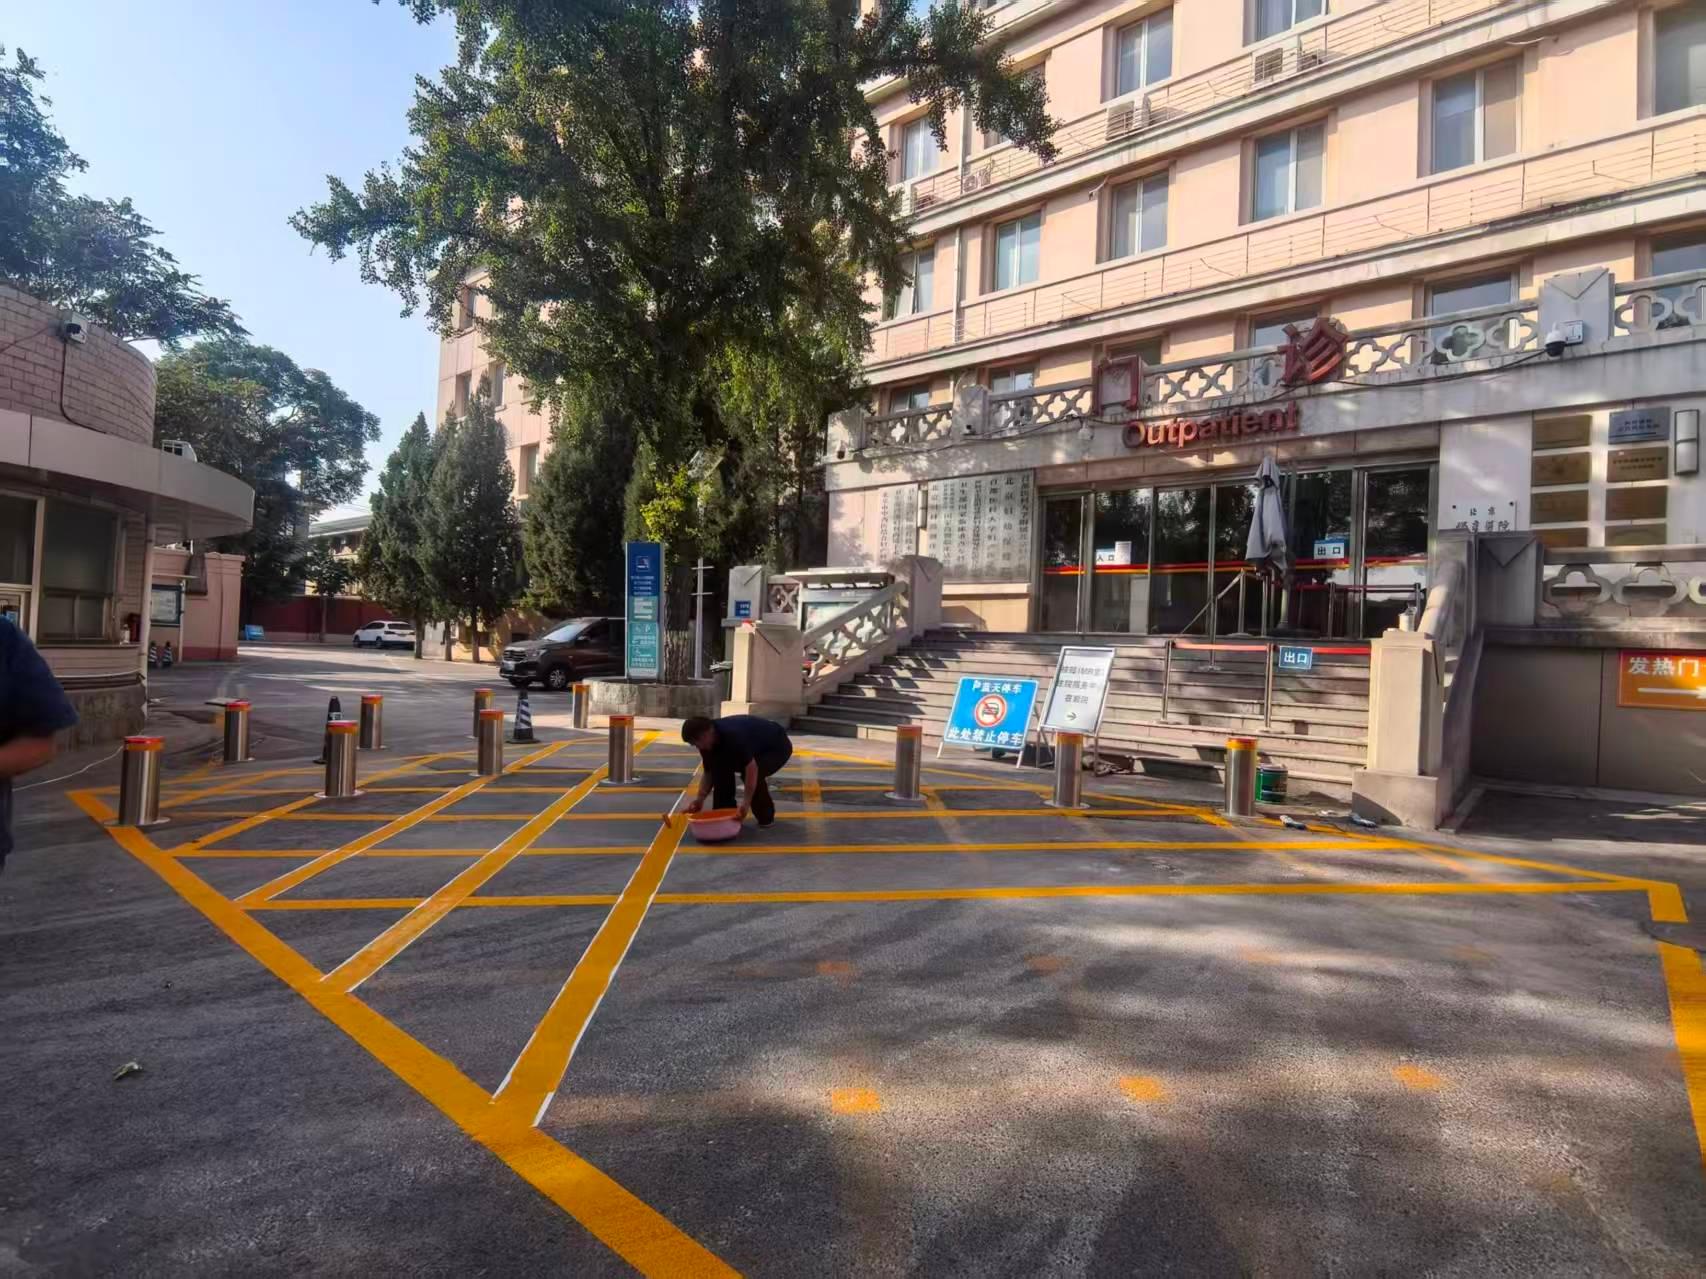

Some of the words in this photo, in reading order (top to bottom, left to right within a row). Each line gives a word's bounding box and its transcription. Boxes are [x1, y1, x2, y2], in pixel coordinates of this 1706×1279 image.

[1123, 400, 1300, 450] Outpatient
[1317, 546, 1341, 556] 出口
[1284, 651, 1308, 665] 出口
[1628, 656, 1706, 677] 发热门
[948, 727, 1024, 745] 此处禁止停车
